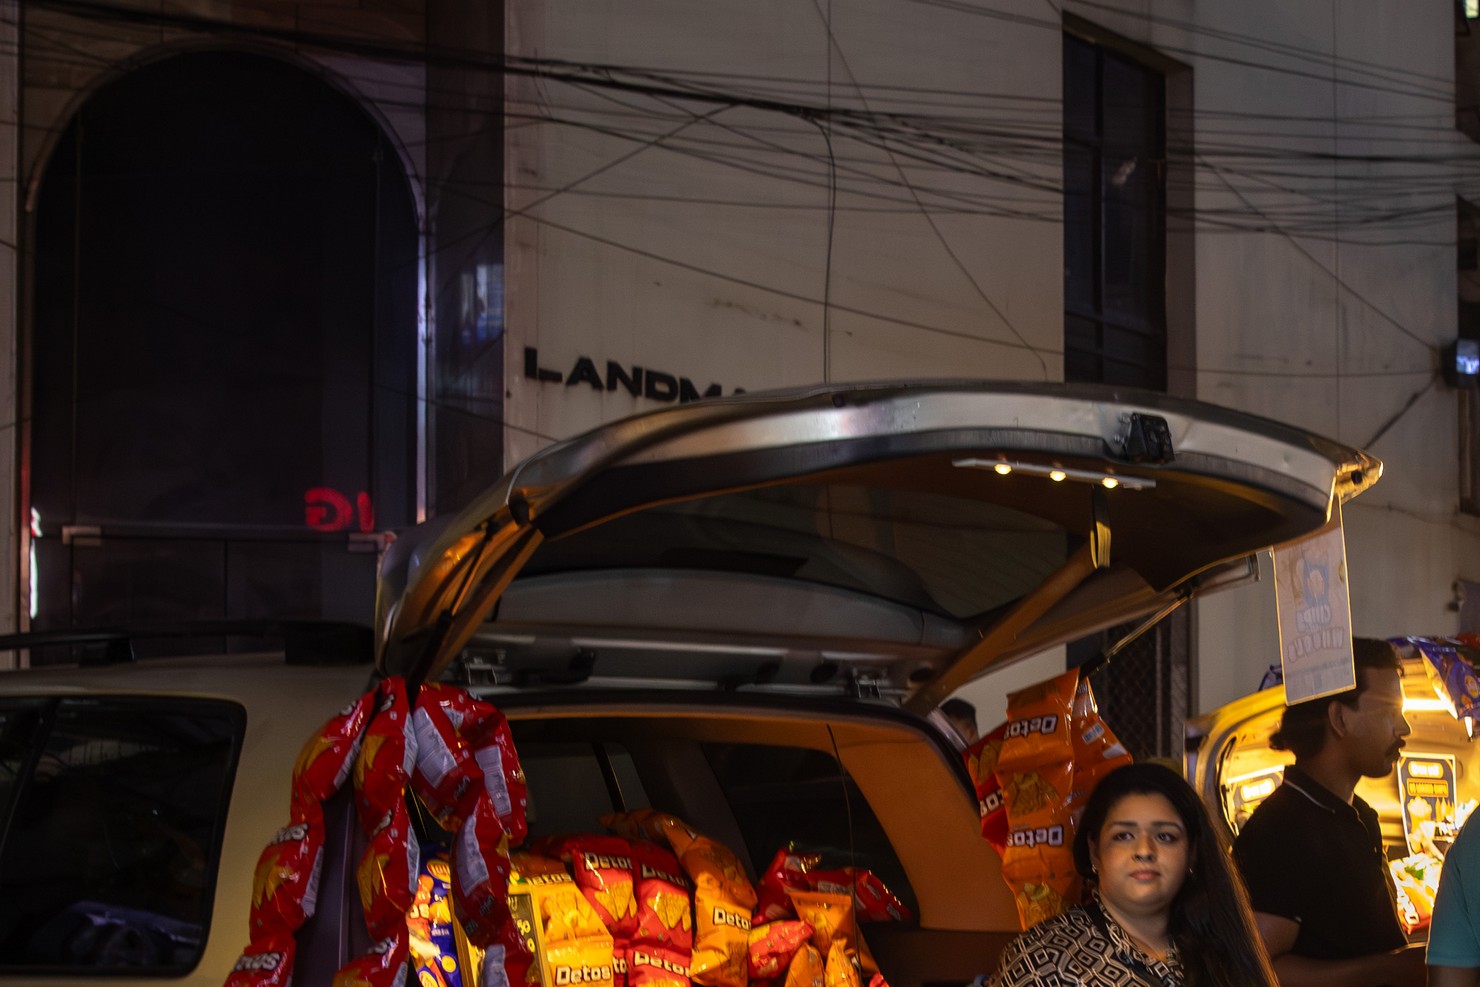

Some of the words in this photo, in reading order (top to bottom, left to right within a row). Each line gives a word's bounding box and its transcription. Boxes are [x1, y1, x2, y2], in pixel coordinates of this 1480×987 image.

[524, 346, 747, 403] LANDM
[527, 871, 572, 886] etos
[640, 863, 690, 886] Deto
[713, 906, 751, 930] Deto
[556, 964, 612, 986] Detos
